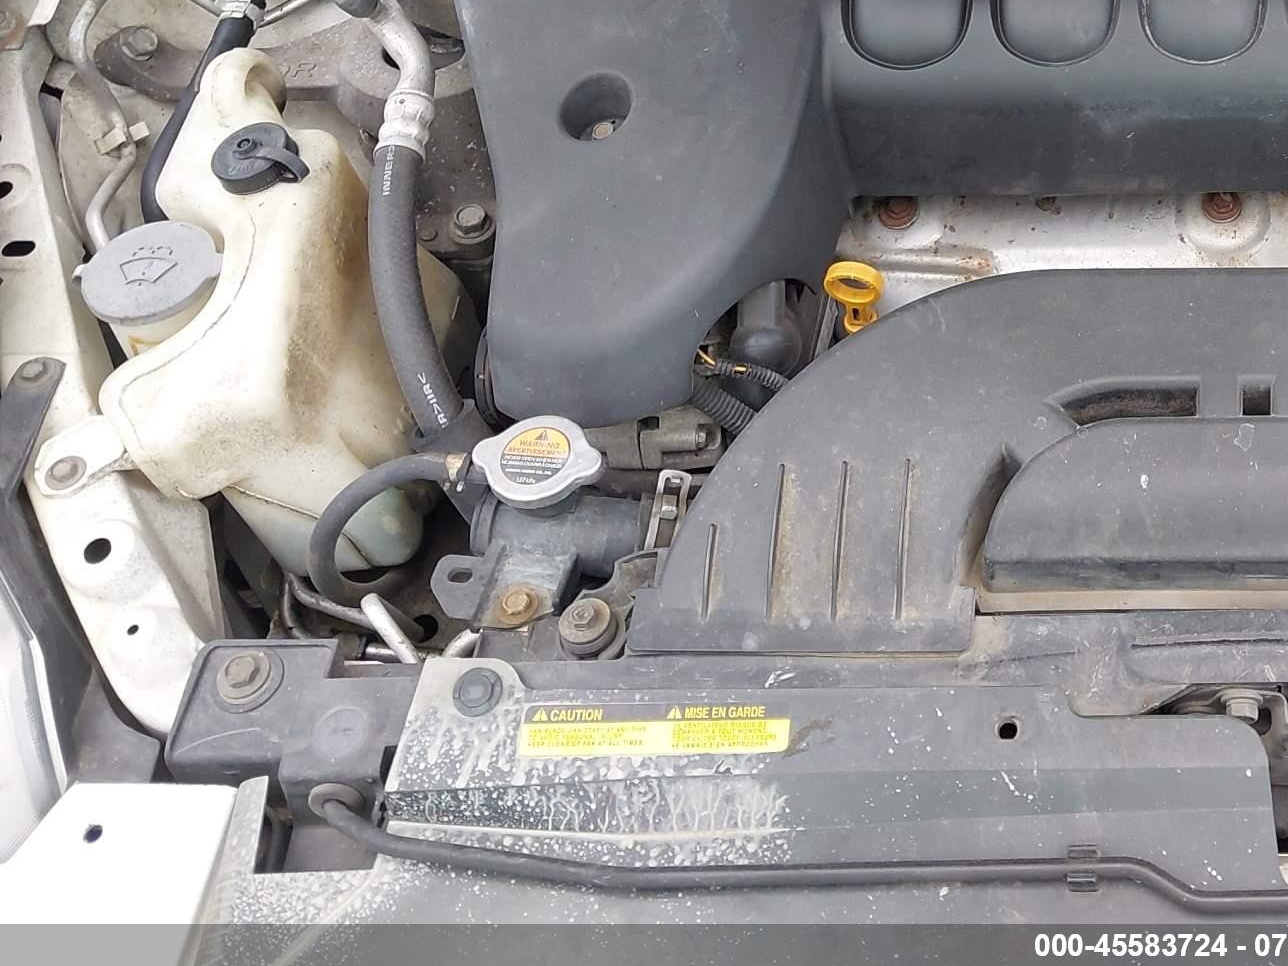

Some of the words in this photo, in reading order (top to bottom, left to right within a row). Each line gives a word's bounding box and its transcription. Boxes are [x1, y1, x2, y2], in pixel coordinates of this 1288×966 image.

[520, 440, 560, 449] WARNING
[550, 708, 603, 721] CAUTION
[685, 707, 710, 718] MISE
[712, 707, 726, 717] EN
[728, 706, 766, 717] GARDE
